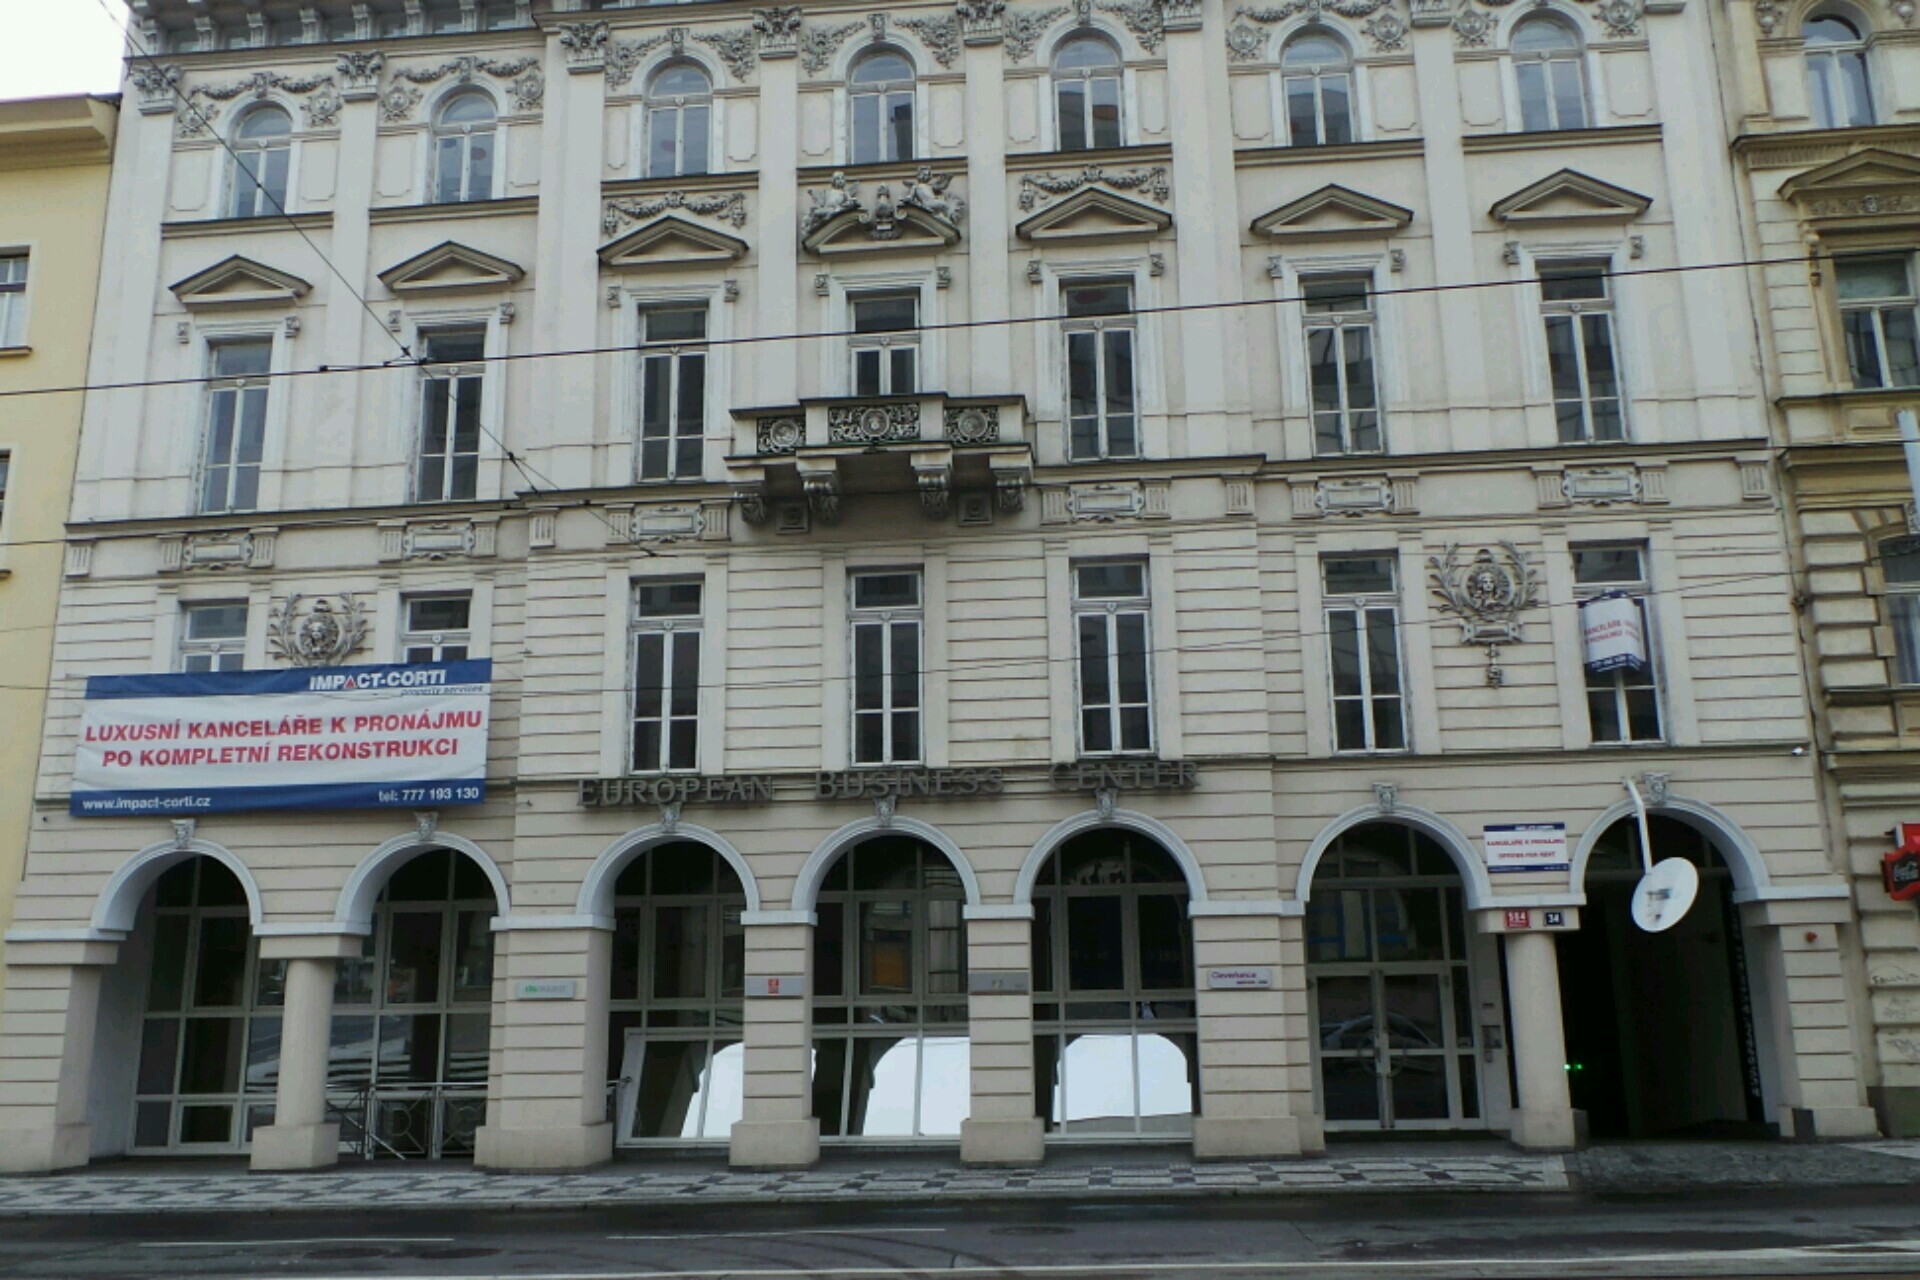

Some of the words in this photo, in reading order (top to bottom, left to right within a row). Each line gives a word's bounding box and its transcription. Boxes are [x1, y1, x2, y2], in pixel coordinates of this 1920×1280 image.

[85, 718, 181, 742] LUXUSNÍ
[187, 714, 322, 739] KANCELÁŘE
[331, 716, 346, 733] K
[354, 708, 482, 732] PRONÁJMU
[102, 750, 133, 767] PO
[140, 741, 271, 767] KOMPLETNÍ
[277, 738, 458, 762] REKONSTRUKCI
[401, 788, 425, 801] 777
[456, 786, 479, 800] 130
[577, 776, 774, 807] EUROPEAN
[815, 768, 1004, 799] BUSINESS
[1050, 761, 1199, 790] CENTER
[82, 795, 212, 811] www.impact-corti.cz
